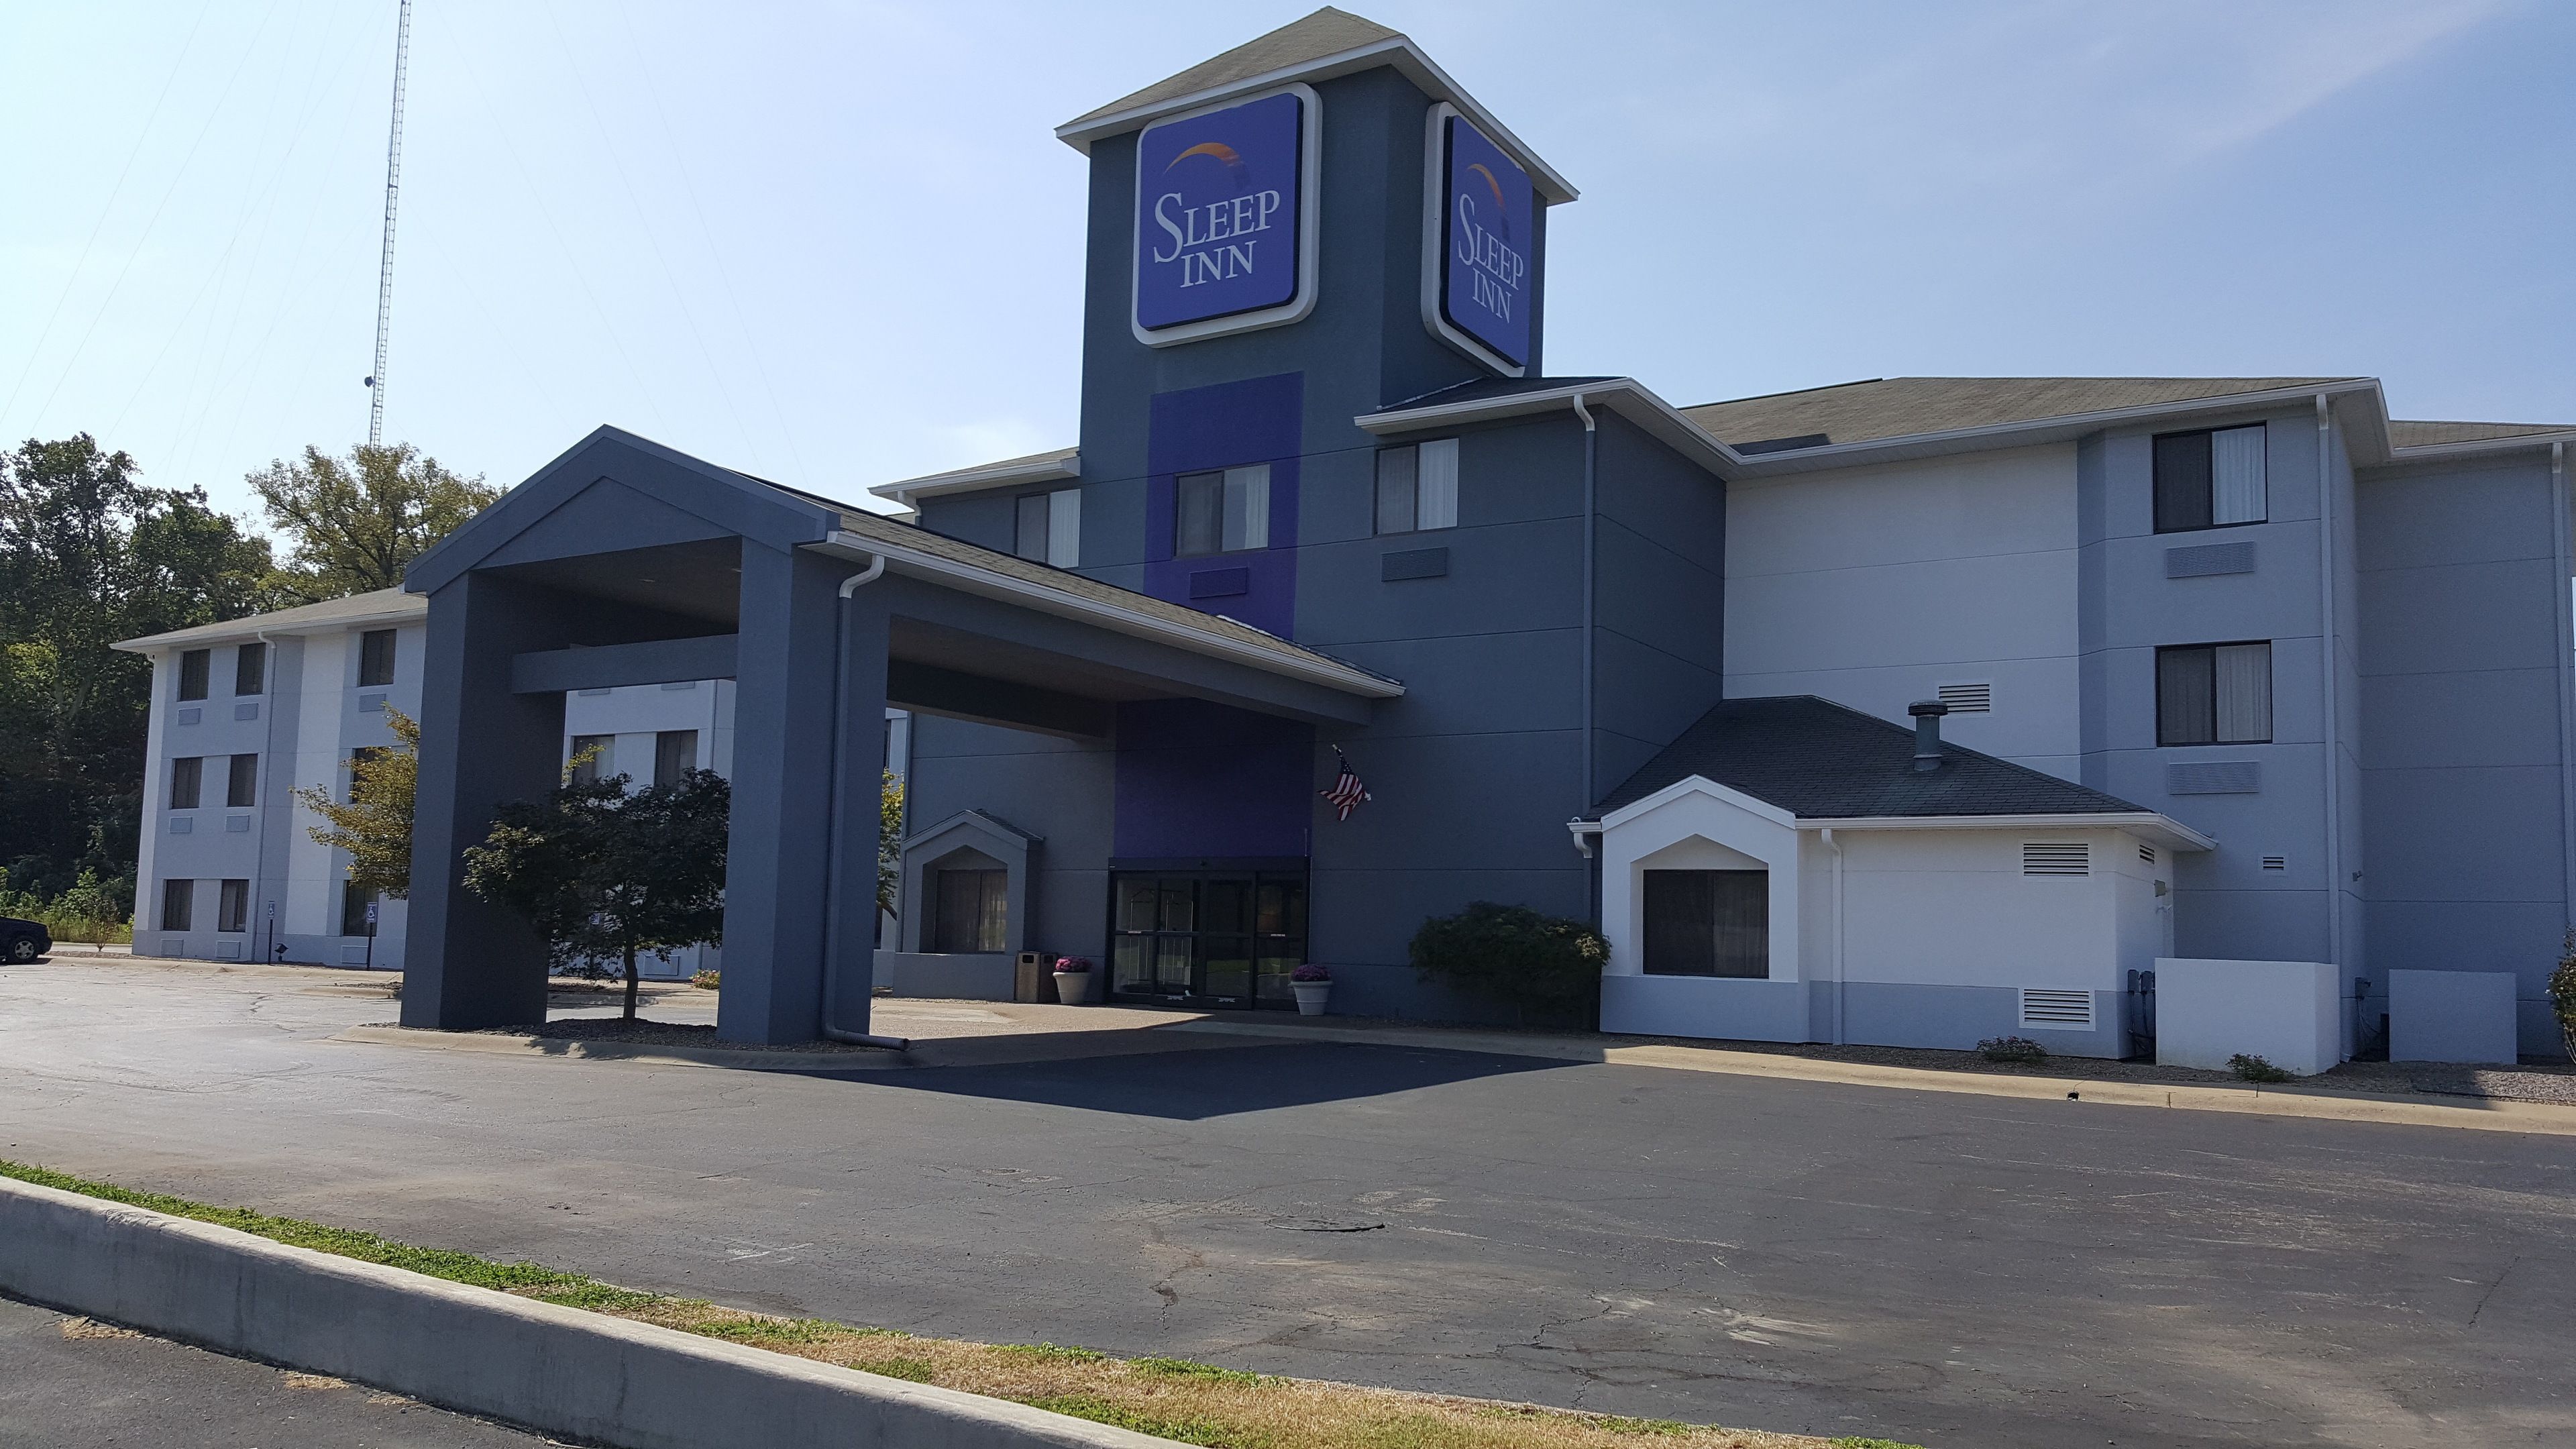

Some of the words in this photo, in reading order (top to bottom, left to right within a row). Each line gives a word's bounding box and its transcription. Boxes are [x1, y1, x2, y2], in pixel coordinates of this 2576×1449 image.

[1153, 190, 1280, 264] SLEEP
[1458, 193, 1523, 290] SLEEP
[1180, 240, 1256, 288] INN
[1472, 267, 1511, 323] INN
